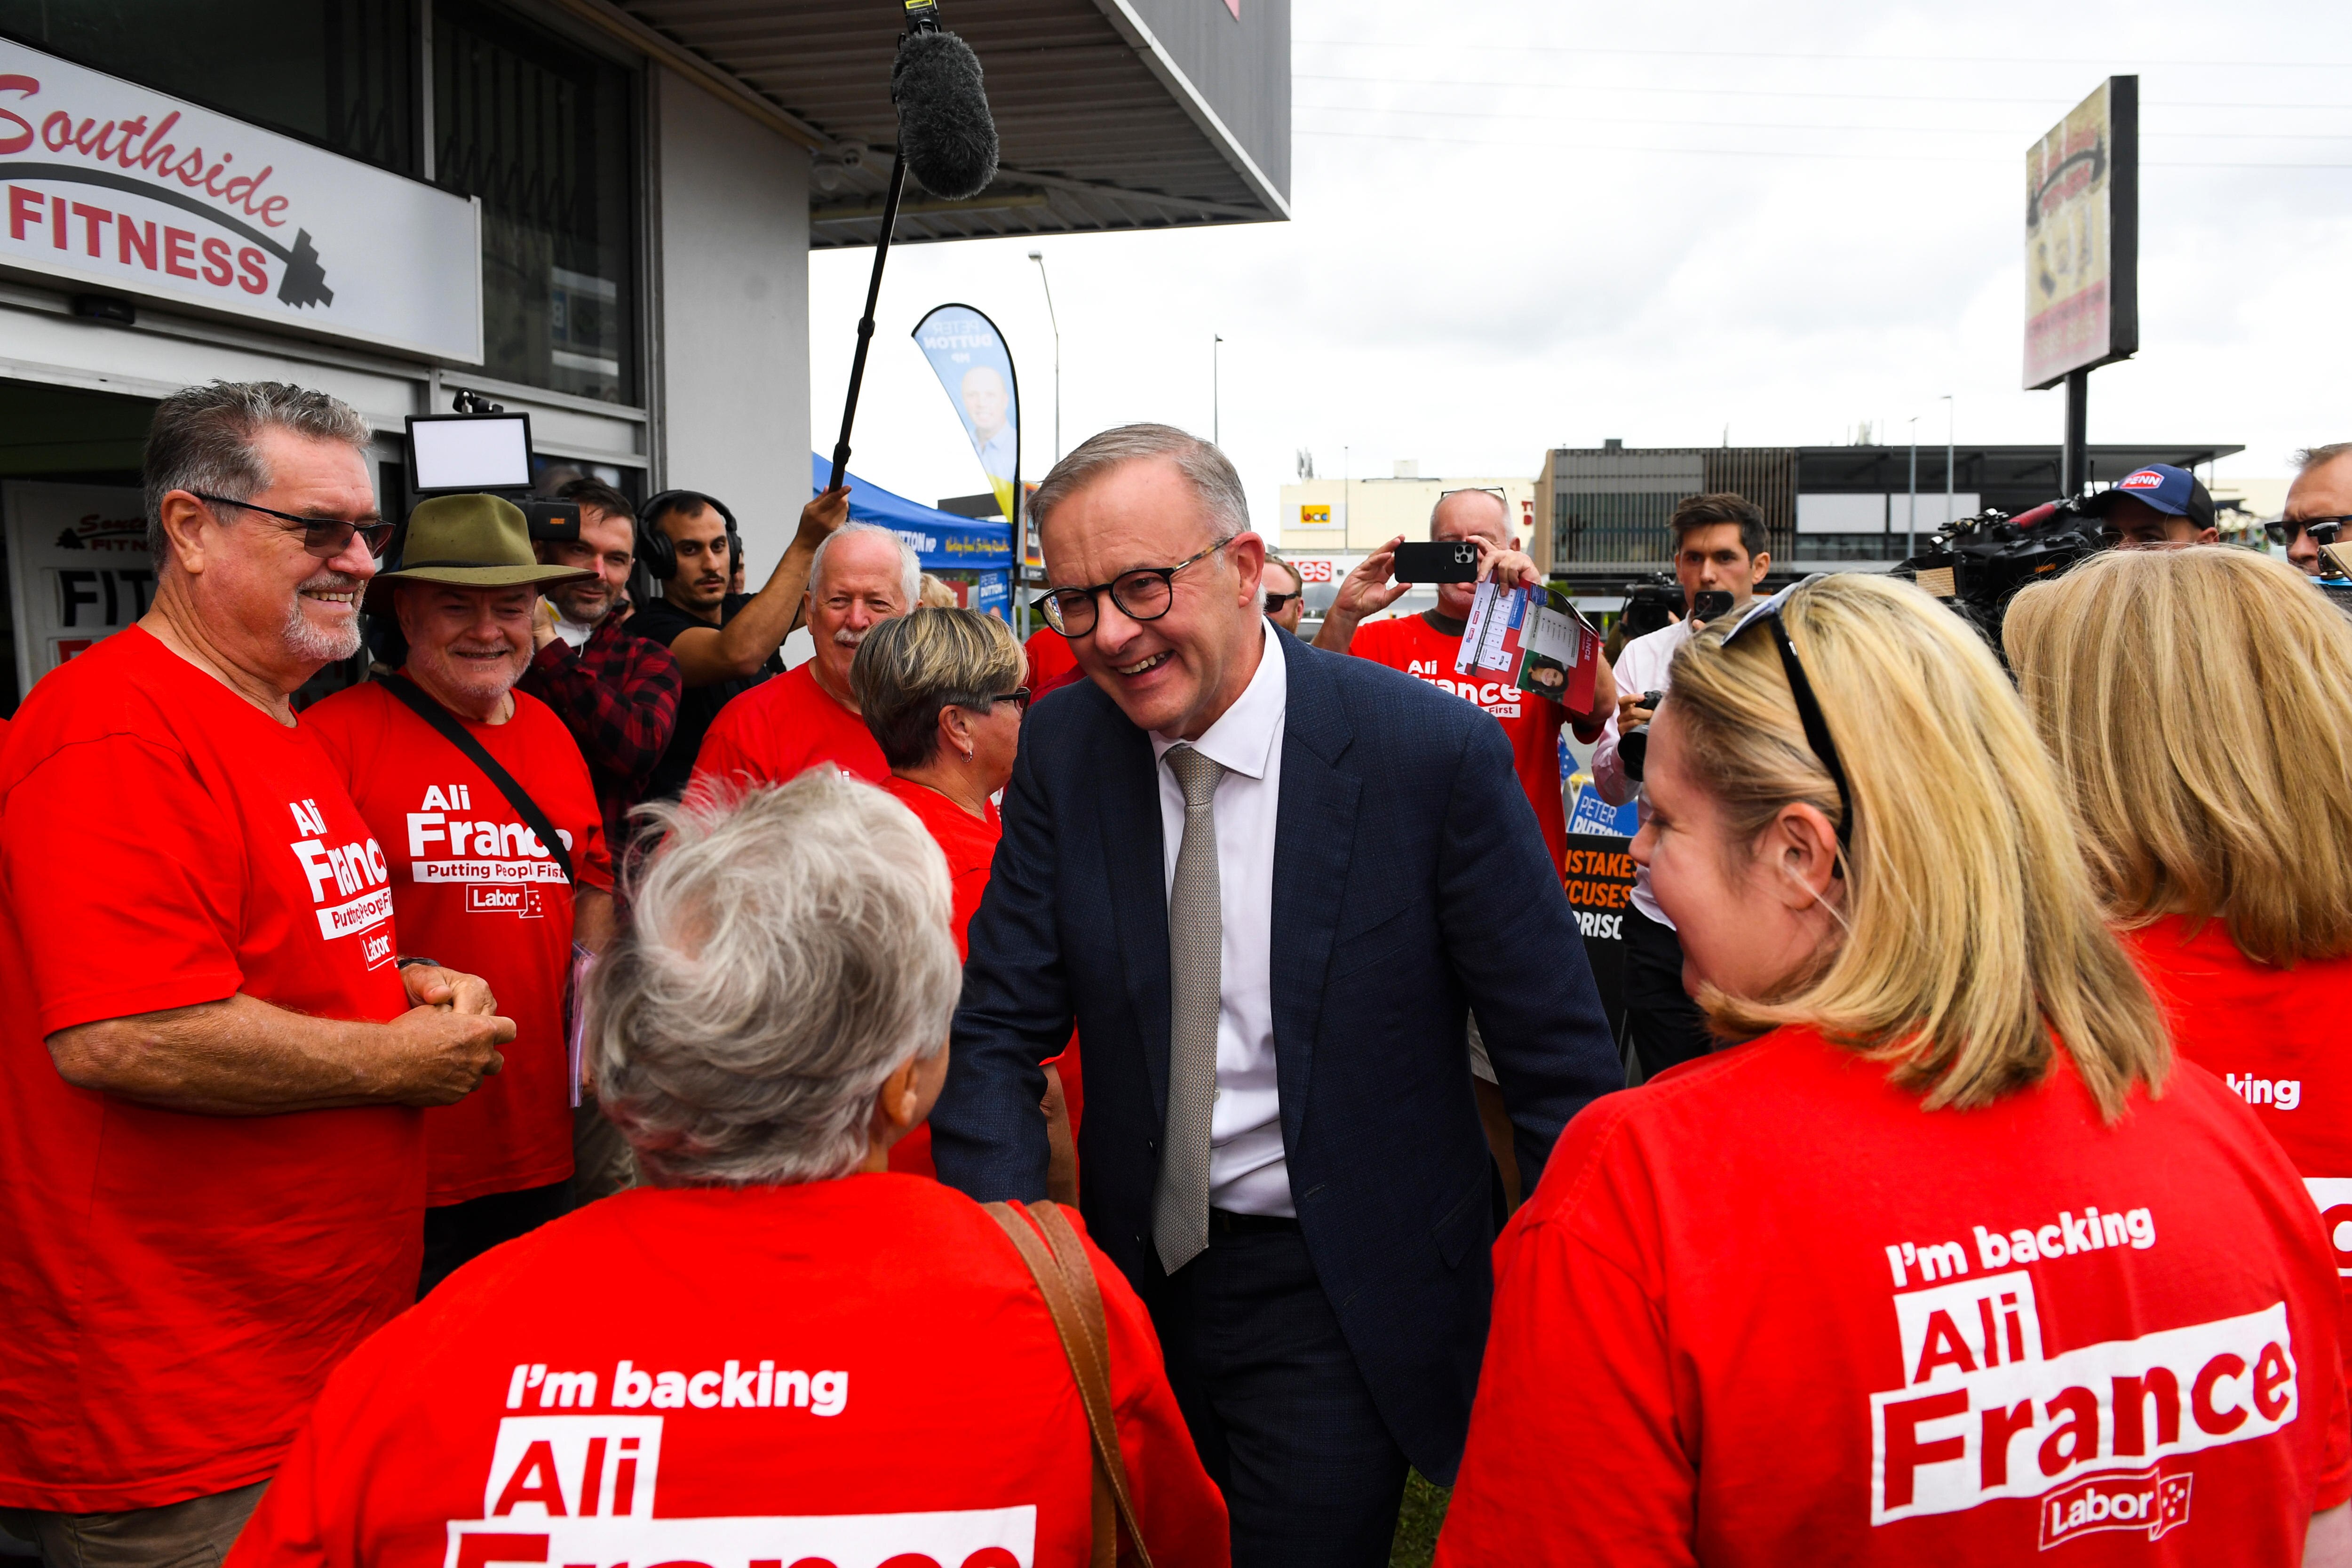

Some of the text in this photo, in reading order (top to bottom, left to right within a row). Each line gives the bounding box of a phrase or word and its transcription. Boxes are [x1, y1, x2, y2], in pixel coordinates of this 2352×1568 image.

[0, 74, 289, 227] Southside
[8, 185, 268, 295] FITNESS
[2122, 475, 2160, 486] PENN
[894, 530, 926, 552] TTON
[1407, 660, 1438, 675] Ali
[1412, 673, 1522, 704] ance
[421, 784, 471, 811] Ali
[1579, 796, 1617, 825] PETER
[289, 798, 327, 837] Ali
[290, 838, 387, 903] Franc
[427, 863, 490, 878] Putting
[495, 864, 533, 879] Peopl
[474, 889, 519, 907] Labor
[362, 935, 390, 963] Labor
[1885, 1206, 2156, 1287] I'm backing
[1912, 1291, 2025, 1385] Ali
[506, 1361, 848, 1416] I'm backing
[1883, 1340, 2290, 1512] France
[492, 1437, 640, 1518] Ali
[2051, 1487, 2154, 1536] Labor
